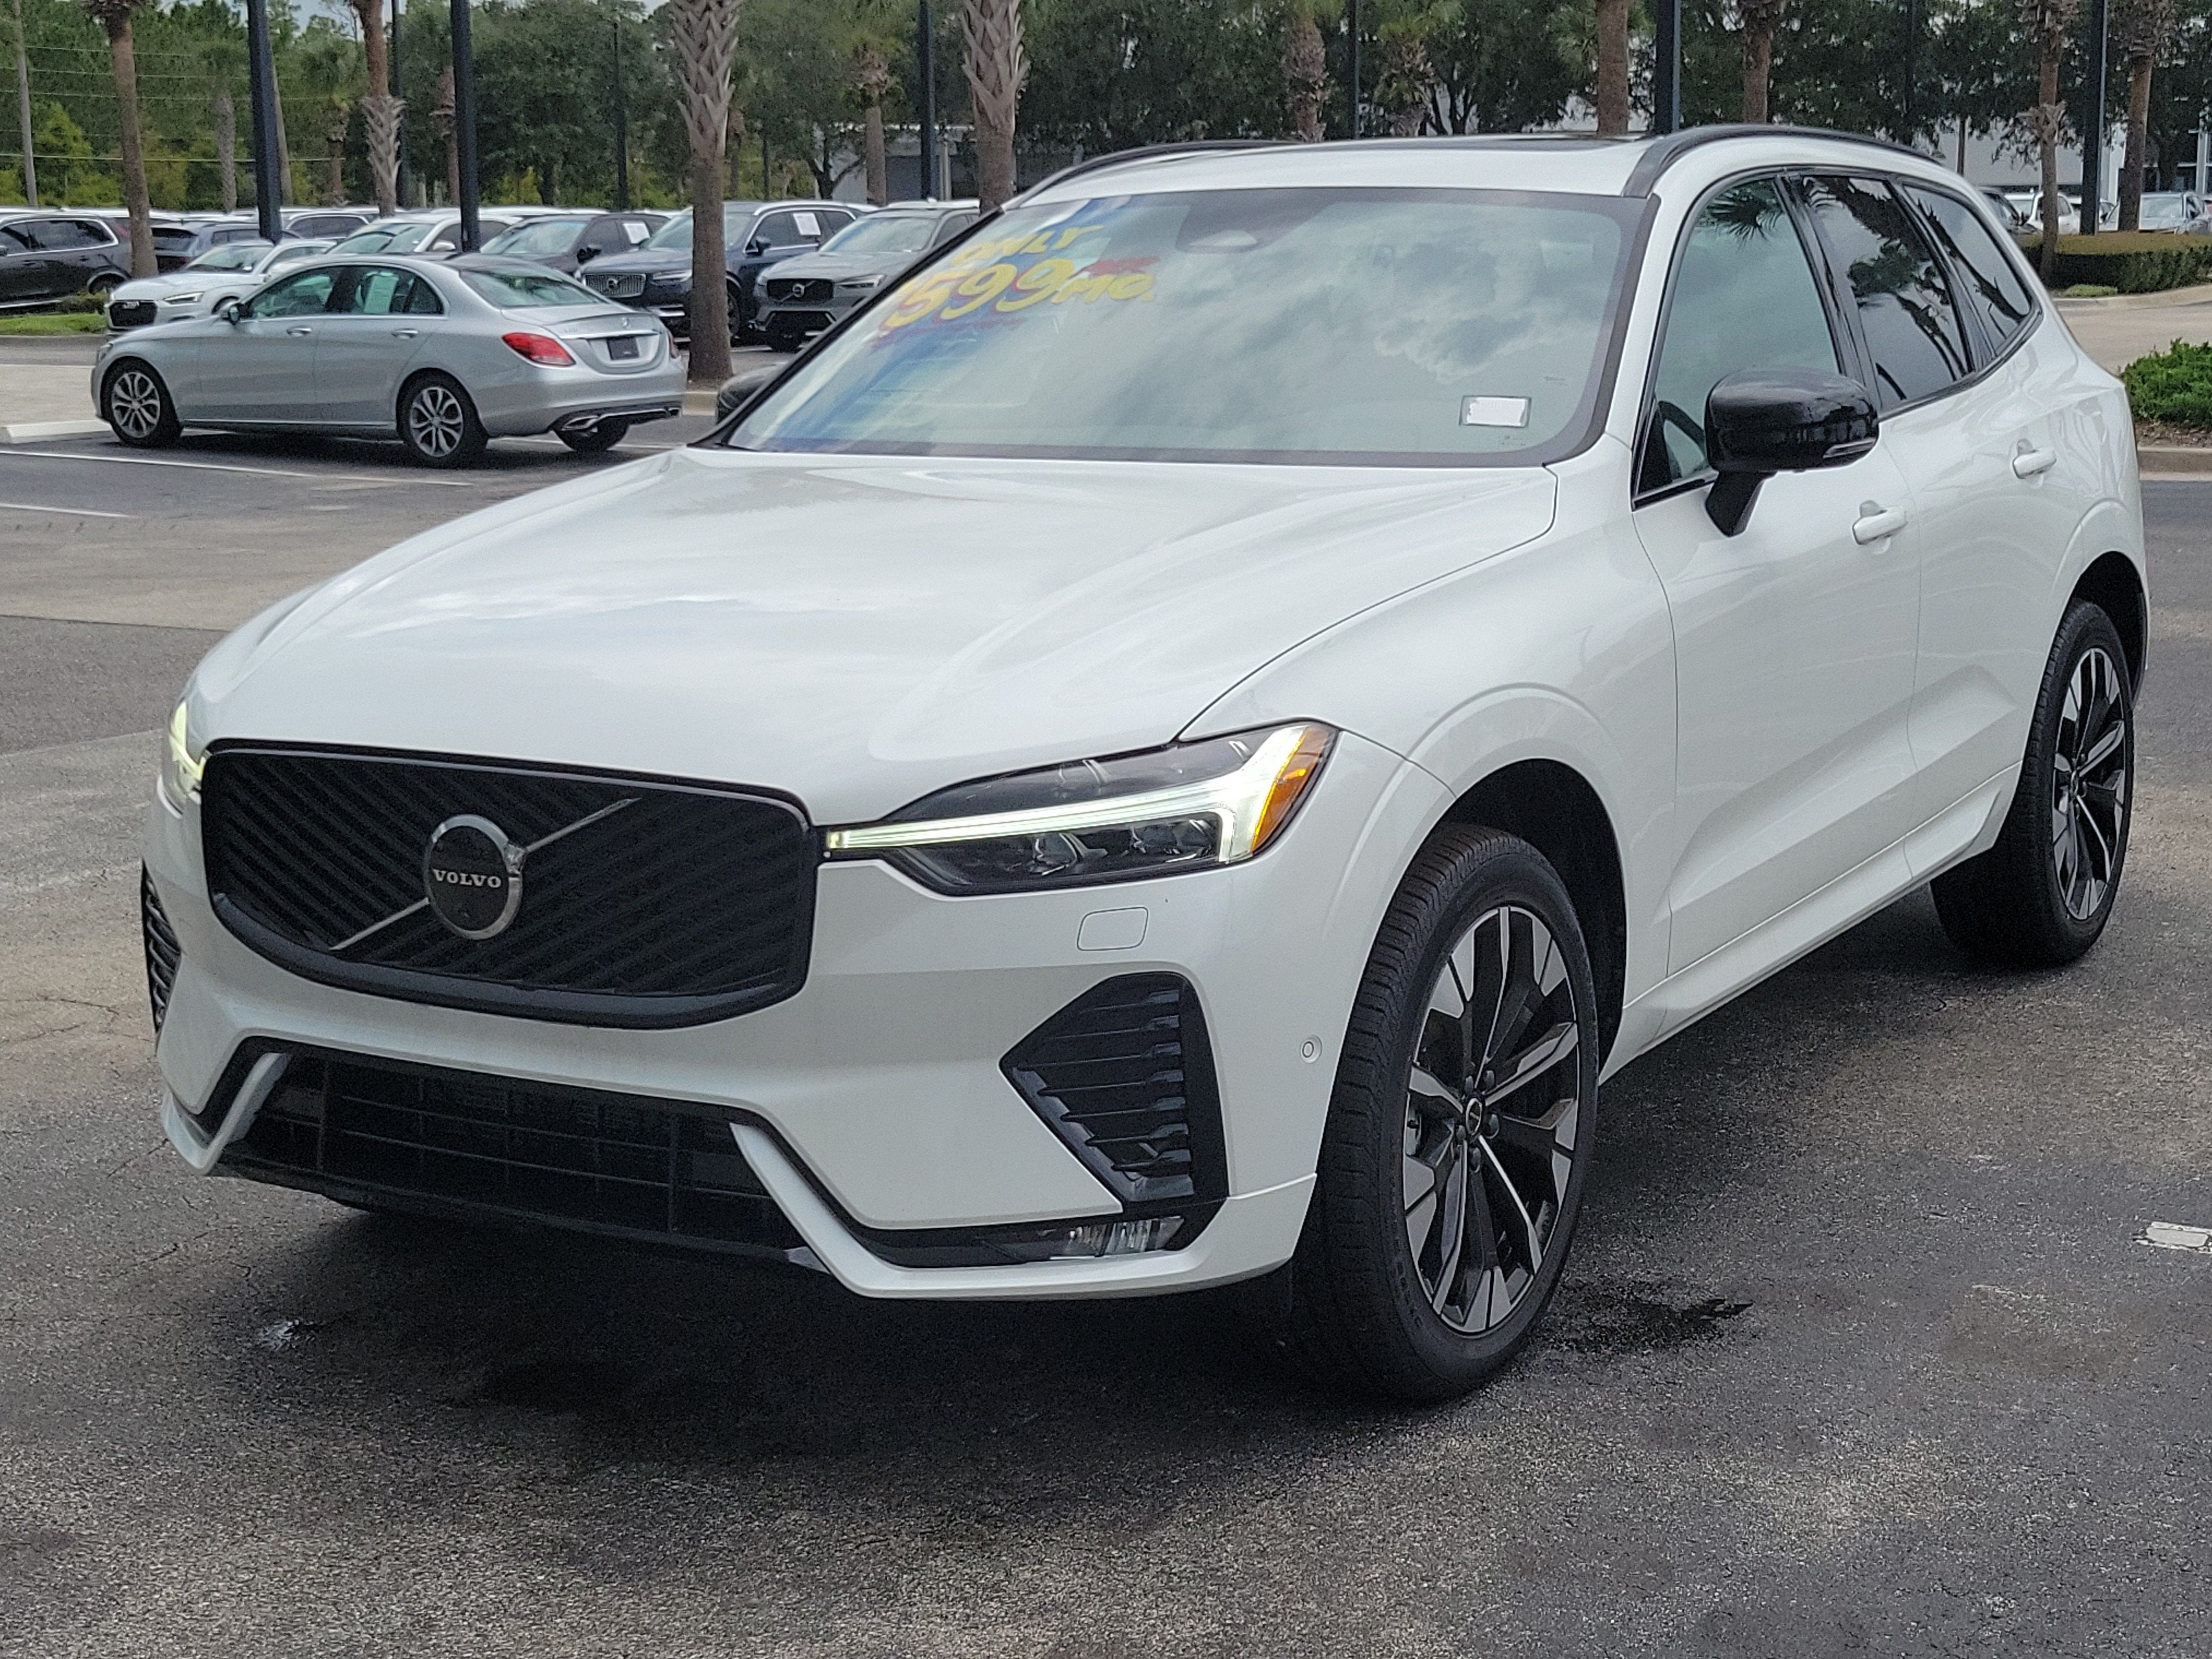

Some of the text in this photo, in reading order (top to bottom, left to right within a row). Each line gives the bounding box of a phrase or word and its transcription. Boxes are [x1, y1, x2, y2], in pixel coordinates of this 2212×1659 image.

[951, 225, 1104, 266] ONLY
[881, 258, 1075, 328] 599
[432, 868, 501, 888] VOLVO
